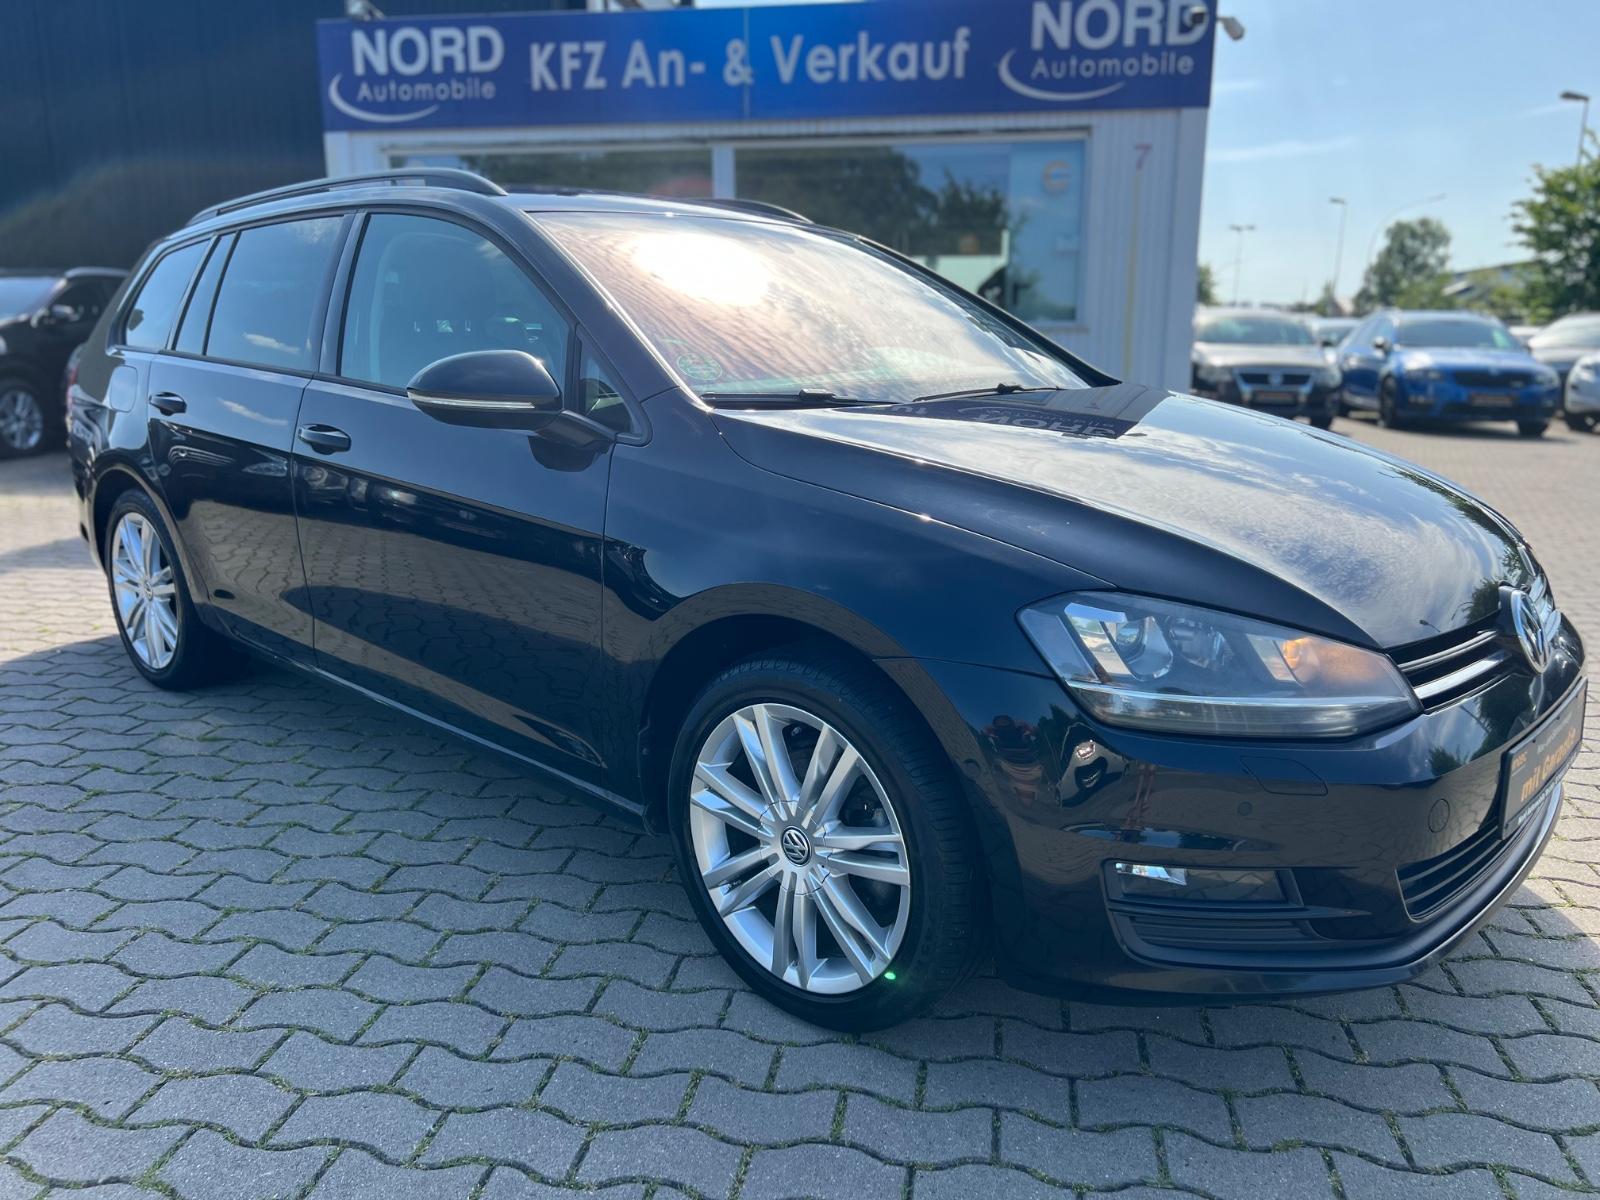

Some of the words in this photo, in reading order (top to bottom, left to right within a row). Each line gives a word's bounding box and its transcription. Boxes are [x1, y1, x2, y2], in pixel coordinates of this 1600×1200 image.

[1031, 0, 1209, 50] NORD
[351, 26, 505, 76] NORD
[530, 42, 607, 91] KFZ
[621, 39, 706, 88] An-
[723, 38, 754, 86] &
[769, 26, 971, 84] Verkauf
[1030, 52, 1194, 80] Automobile
[357, 77, 497, 101] Automobile
[1135, 144, 1152, 171] 7
